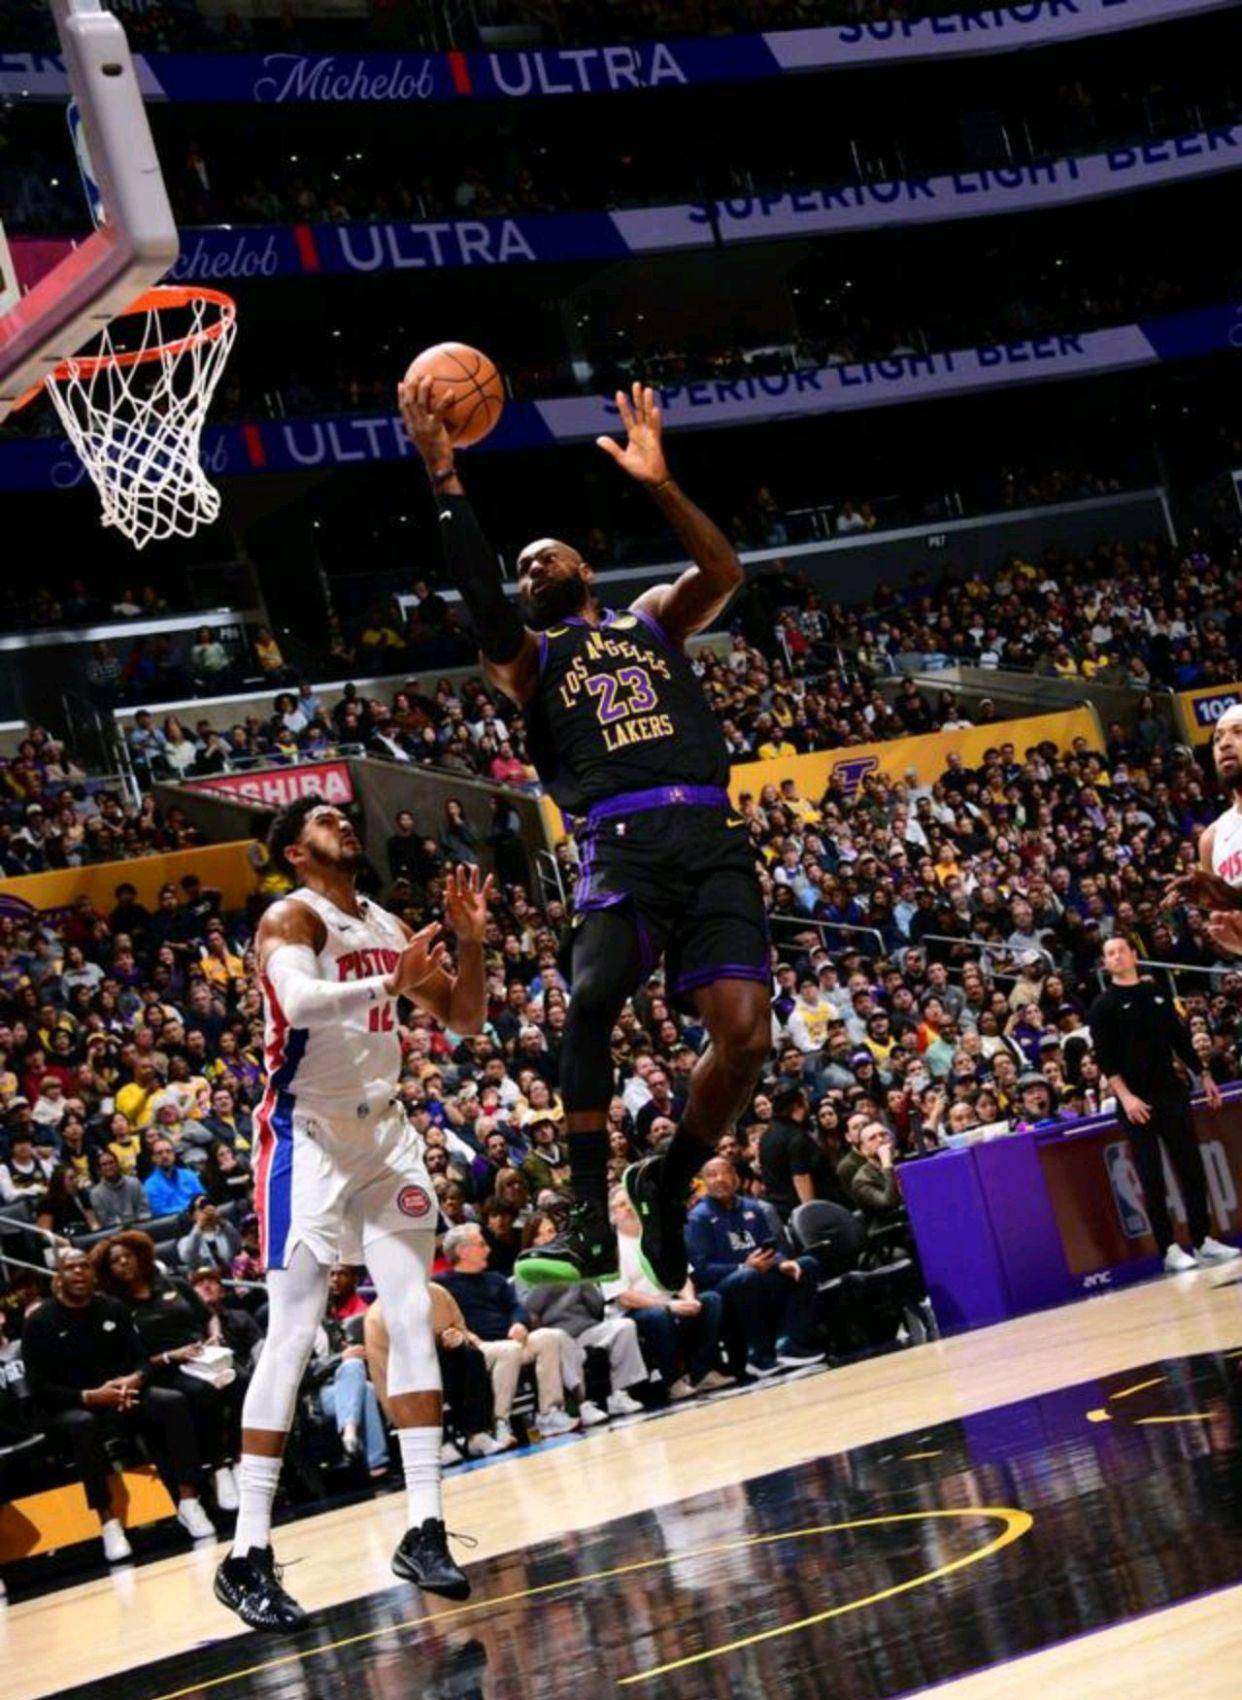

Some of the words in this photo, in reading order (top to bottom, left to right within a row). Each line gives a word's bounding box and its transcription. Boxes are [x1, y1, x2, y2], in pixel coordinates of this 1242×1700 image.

[253, 53, 434, 102] Michelob
[489, 43, 688, 96] ULTRA
[170, 234, 279, 280] chelob
[338, 220, 537, 271] ULTRA
[558, 656, 589, 708] LOS
[585, 631, 672, 680] ANGELES
[584, 666, 659, 725] 23
[602, 714, 674, 752] LAKERS
